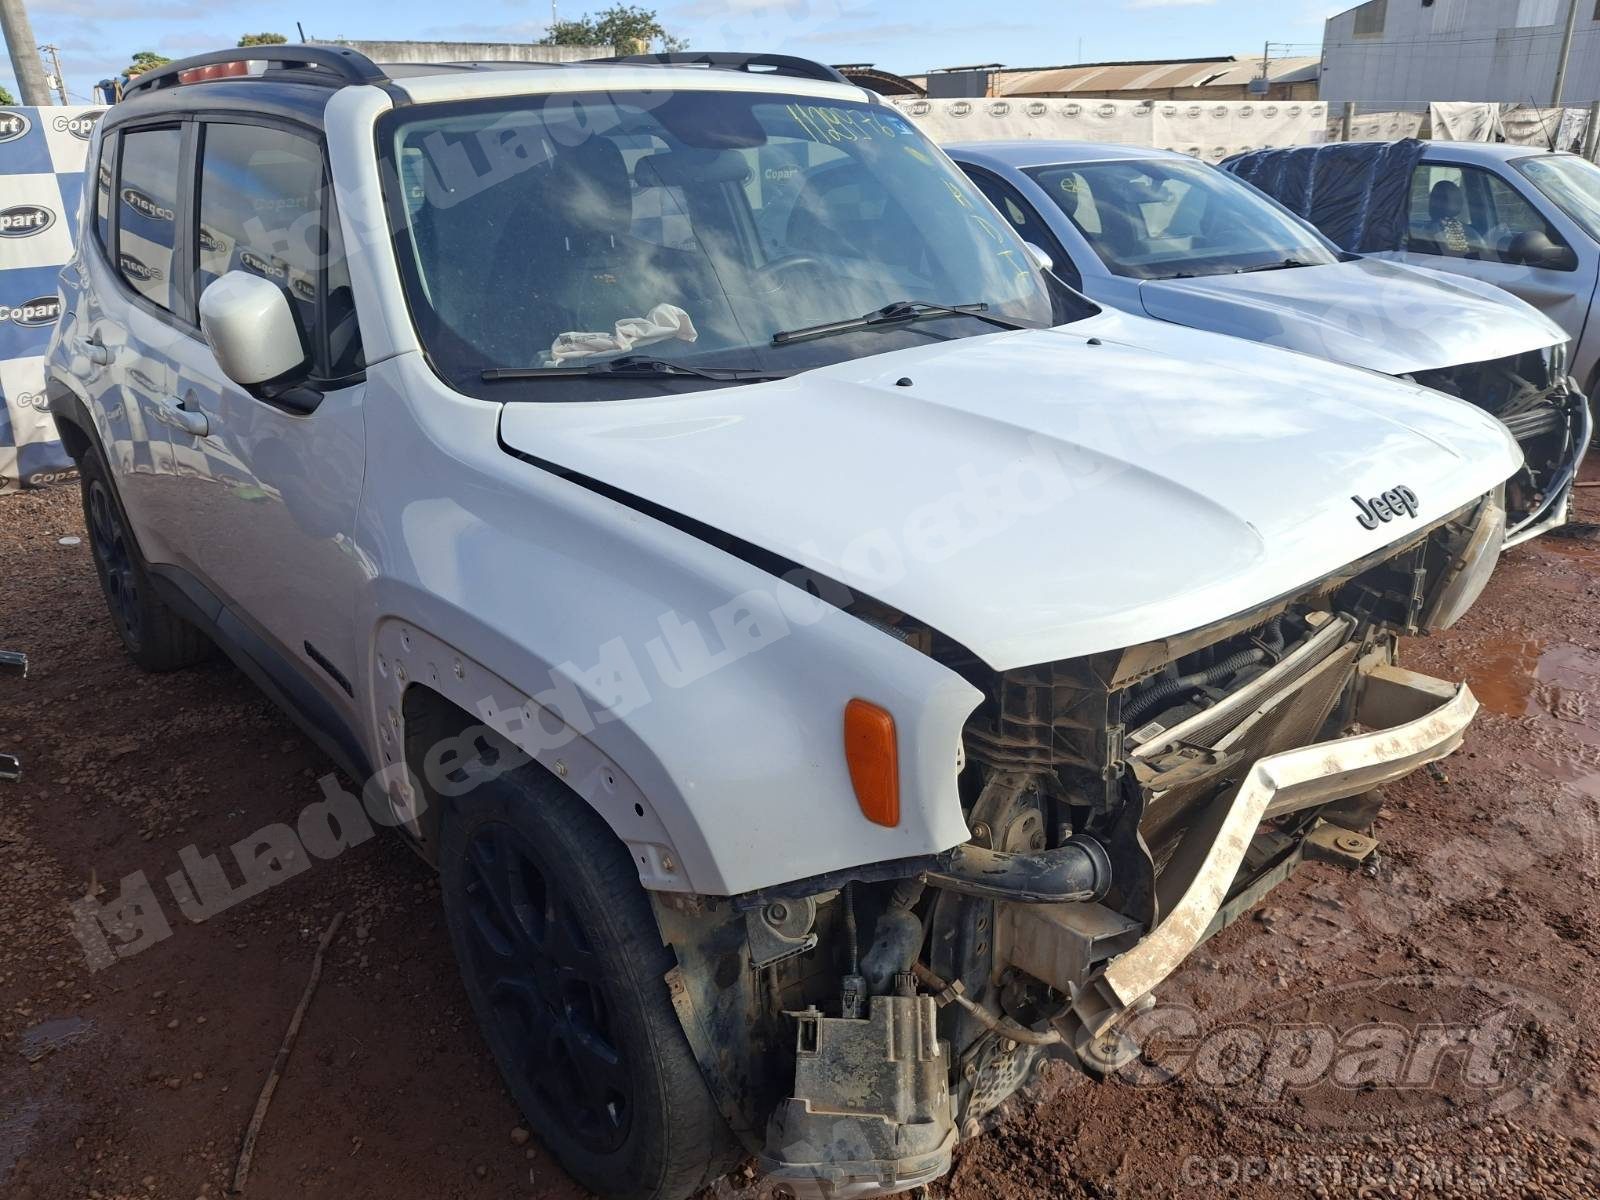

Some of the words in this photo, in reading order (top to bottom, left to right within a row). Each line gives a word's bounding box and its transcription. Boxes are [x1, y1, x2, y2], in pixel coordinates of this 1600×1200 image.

[53, 115, 97, 134] Cop
[0, 210, 44, 232] part
[1350, 484, 1419, 531] Jeep
